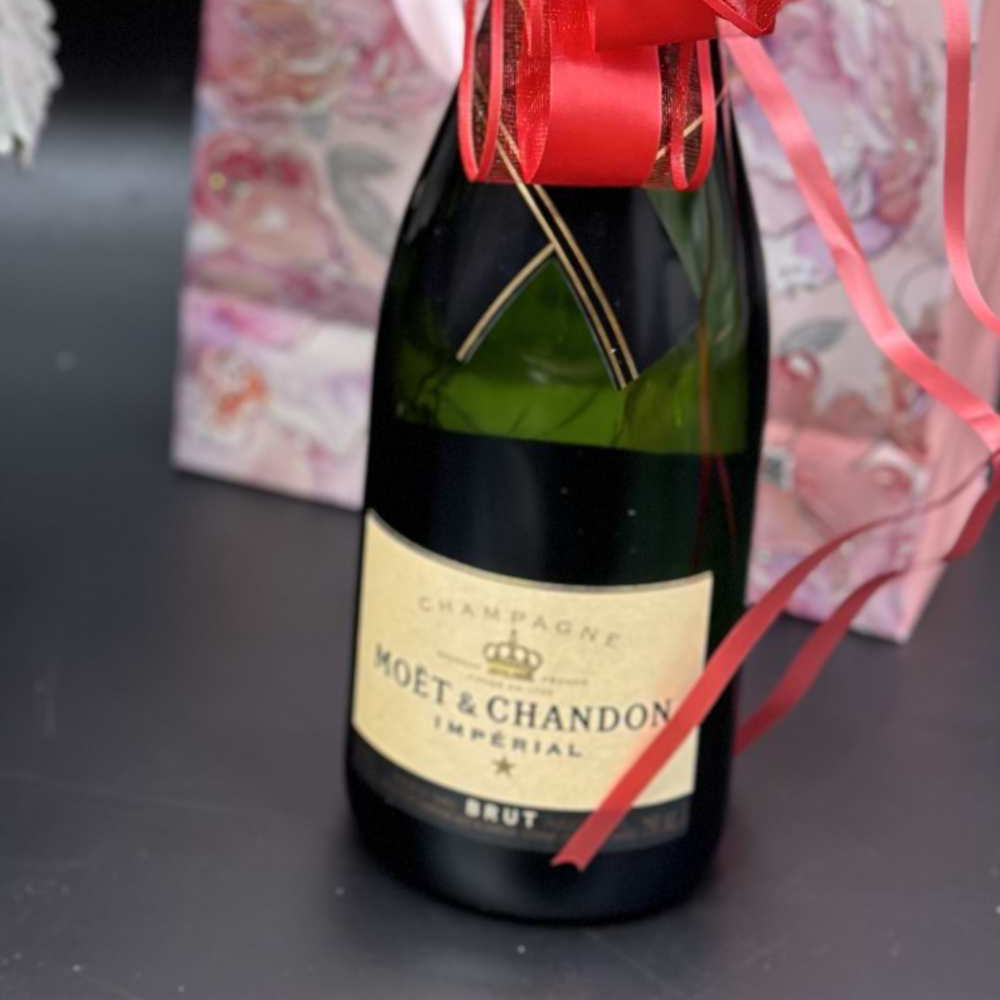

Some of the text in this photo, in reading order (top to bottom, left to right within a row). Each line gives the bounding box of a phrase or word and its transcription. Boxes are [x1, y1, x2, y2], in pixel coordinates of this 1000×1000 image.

[418, 596, 621, 648] CHAMPAGNE
[457, 691, 477, 717] &
[486, 694, 672, 733] CHANDON
[434, 714, 582, 758] IMPÉRIAL
[464, 797, 539, 829] BRUT
